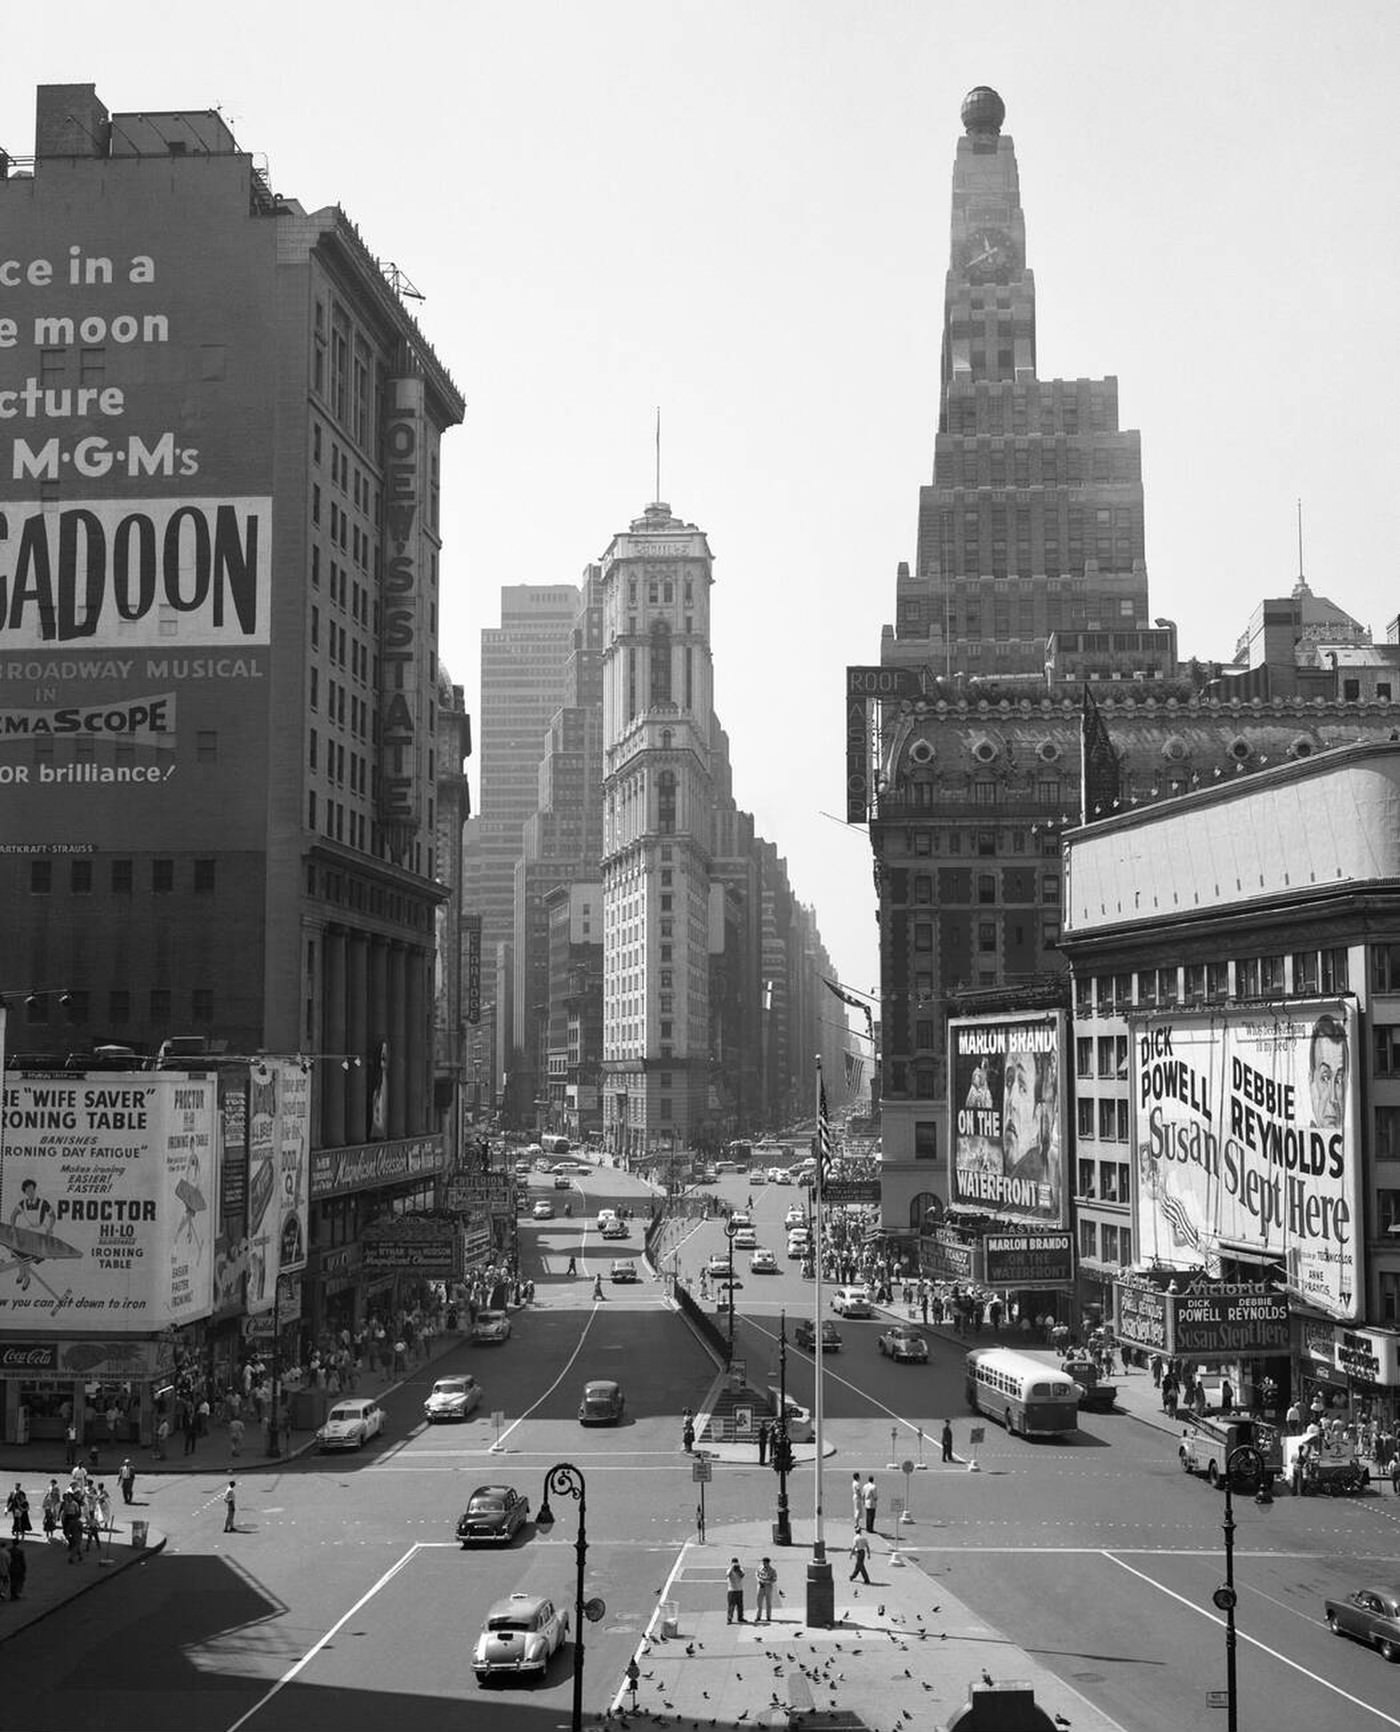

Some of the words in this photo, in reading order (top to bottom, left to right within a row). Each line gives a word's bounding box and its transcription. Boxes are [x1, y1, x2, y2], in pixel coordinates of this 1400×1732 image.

[69, 246, 113, 284] in
[128, 255, 155, 283] a
[34, 314, 169, 344] moon
[0, 506, 259, 641] ADOON
[0, 660, 134, 680] ROADWAY
[146, 659, 263, 678] MUSICAL
[850, 672, 904, 691] ROOF
[35, 687, 56, 702] IN
[0, 699, 168, 734] MASCOPE
[384, 610, 415, 816] STATE
[848, 703, 866, 817] ASTOR
[39, 763, 176, 783] brilliance!
[958, 1028, 1006, 1055] MARLON
[1141, 1026, 1173, 1067] DICK
[1141, 1060, 1212, 1121] POWELL
[1232, 1056, 1295, 1120] DEBBIE
[87, 1111, 147, 1130] TABLE
[957, 1110, 974, 1136] ON
[977, 1110, 1001, 1138] THE
[39, 1135, 98, 1145] BANISHES
[1149, 1106, 1219, 1180] Susan
[1231, 1095, 1344, 1178] REYNOLDS
[61, 1147, 87, 1158] DAY
[67, 1174, 113, 1184] EASIER!
[92, 1165, 126, 1176] ironing
[66, 1183, 113, 1194] FASTER!
[956, 1170, 1038, 1207] WATERFRONT
[1224, 1138, 1283, 1237] Slept
[56, 1200, 157, 1221] PROCTOR
[1288, 1174, 1351, 1244] Here
[91, 1248, 144, 1258] IRONING
[988, 1238, 1028, 1251] MARLON
[1029, 1236, 1069, 1250] BRANDO
[98, 1259, 132, 1269] TABLE
[1007, 1253, 1022, 1265] ON
[1028, 1252, 1050, 1264] THE
[991, 1265, 1067, 1278] WATERFRONT
[12, 1299, 31, 1310] you
[33, 1299, 55, 1308] can
[75, 1297, 104, 1309] down
[108, 1299, 121, 1309] to
[122, 1299, 147, 1309] iron
[1187, 1299, 1211, 1308] DICK
[1238, 1298, 1273, 1307] DEBBIE
[1178, 1309, 1222, 1322] POWELL
[1228, 1306, 1287, 1320] REYNOLDS
[1177, 1324, 1217, 1348] Susan
[1219, 1322, 1256, 1349] Slept
[1256, 1320, 1289, 1345] Here
